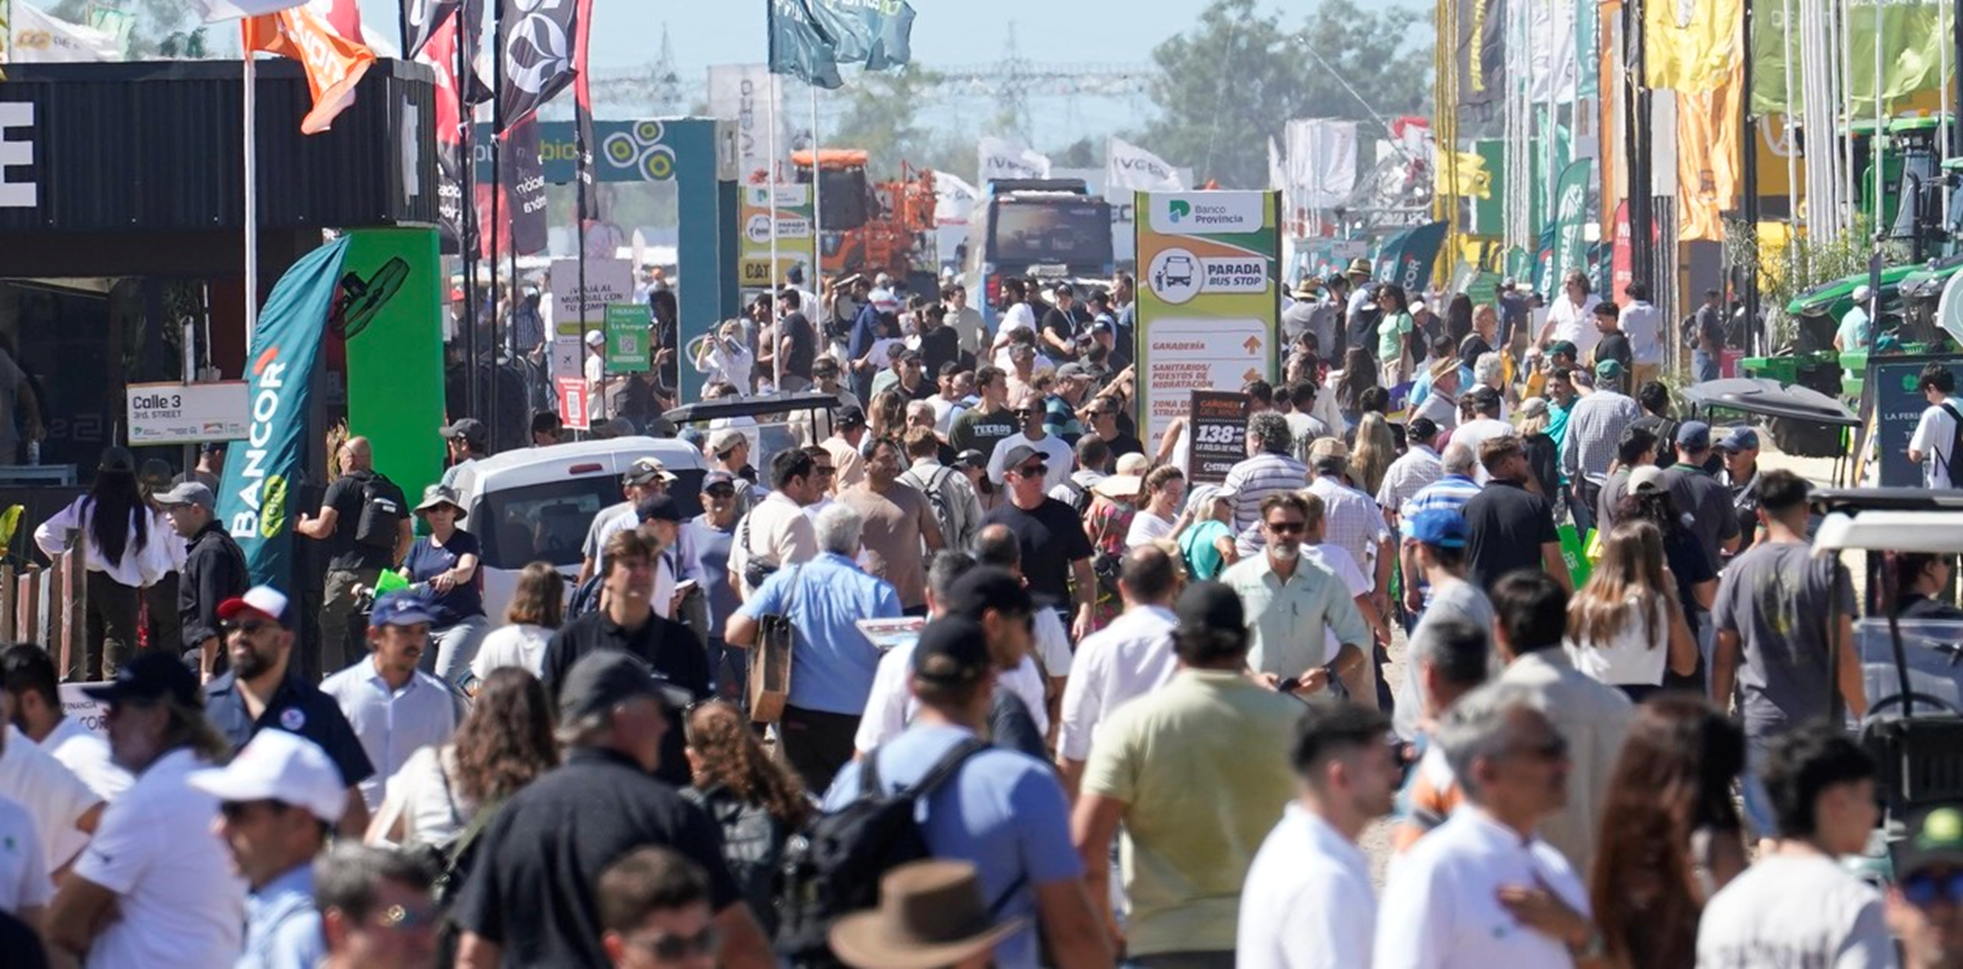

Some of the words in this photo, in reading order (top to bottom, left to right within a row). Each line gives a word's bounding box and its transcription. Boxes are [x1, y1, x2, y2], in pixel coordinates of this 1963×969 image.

[540, 139, 577, 160] bio
[1195, 205, 1226, 214] Banco
[1195, 214, 1243, 224] Provincia
[745, 263, 770, 279] CAT
[1208, 264, 1261, 275] PARADA
[1209, 276, 1230, 286] BUS
[1233, 276, 1261, 286] STOP
[1152, 341, 1206, 350] GANADERÍA
[1152, 363, 1212, 371] SANITARIOS/
[1152, 371, 1193, 380] PUESTOS
[1152, 380, 1214, 389] HIDRATACIÓN
[133, 394, 168, 409] Calle
[171, 394, 181, 408] 3
[1153, 400, 1178, 408] ZONA
[133, 411, 149, 419] 3rd.
[152, 410, 182, 419] STREET
[1153, 409, 1192, 417] STREAM
[1884, 412, 1897, 420] LA
[1196, 424, 1235, 443] 138
[230, 361, 287, 538] BANCOR
